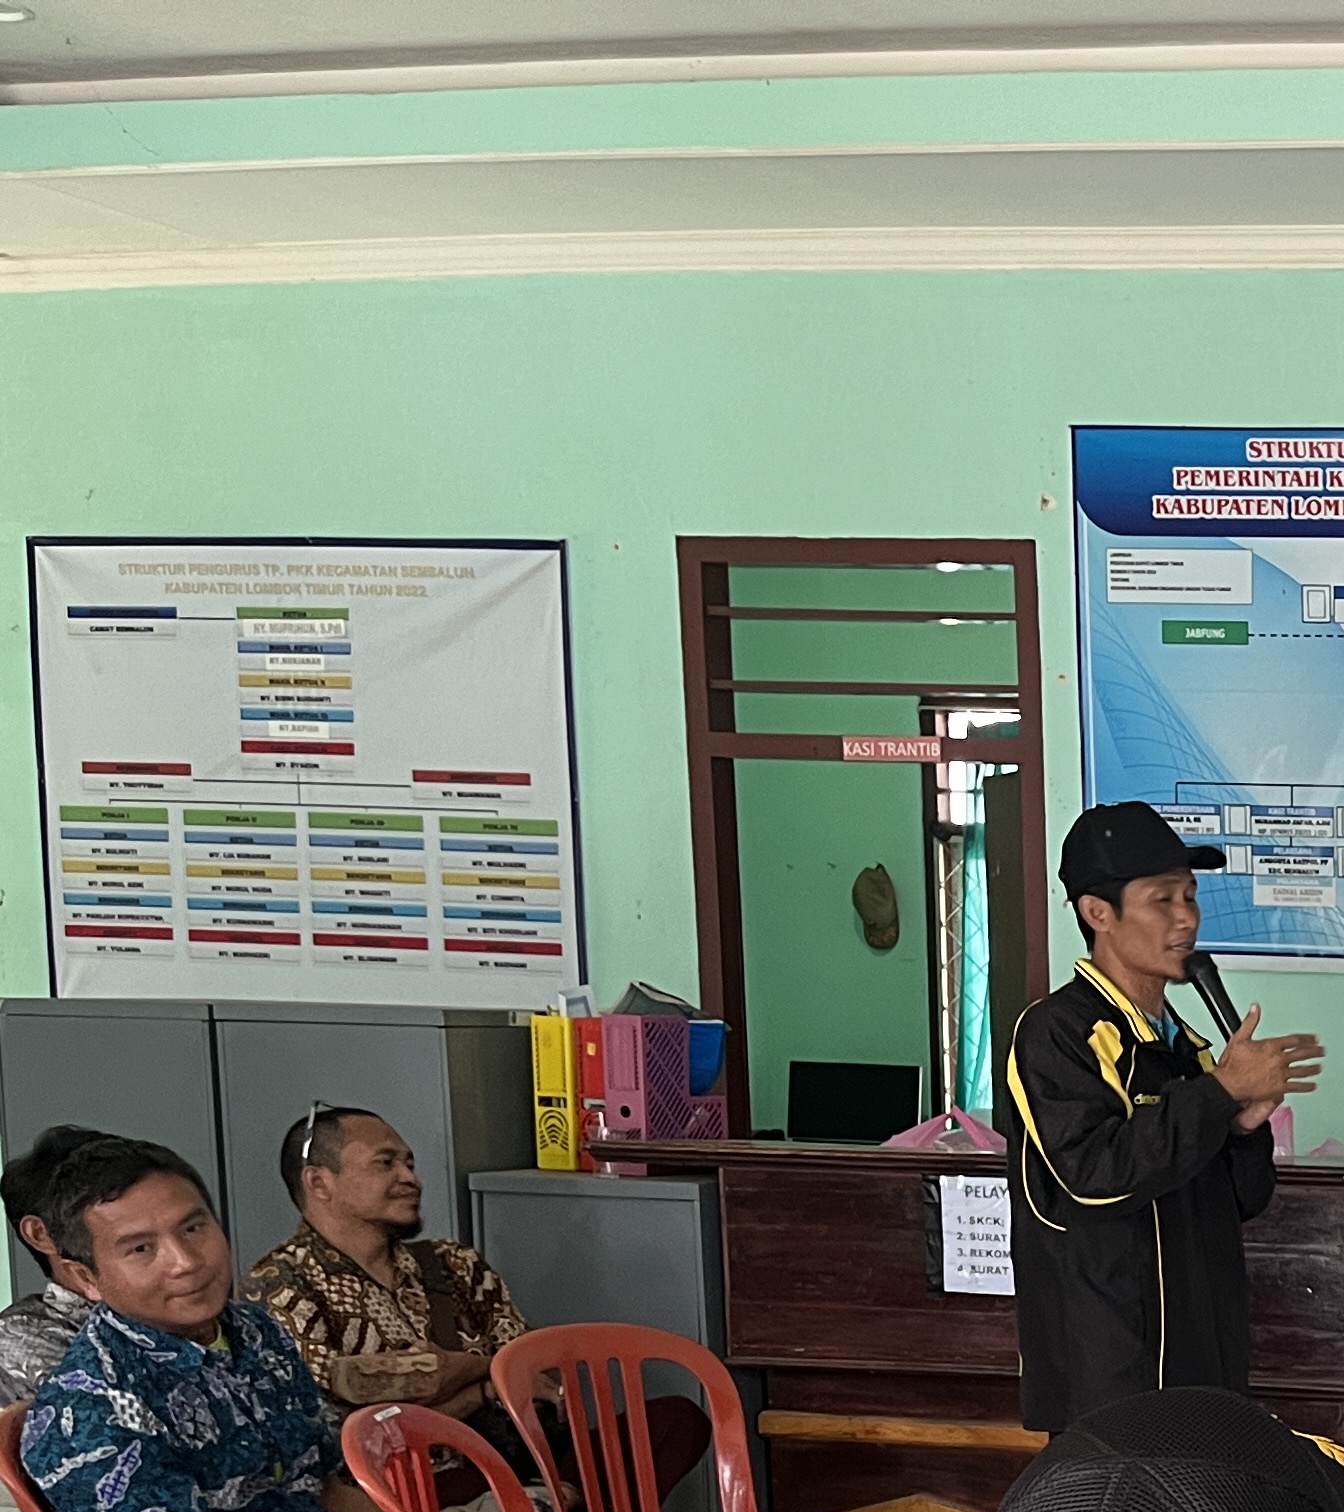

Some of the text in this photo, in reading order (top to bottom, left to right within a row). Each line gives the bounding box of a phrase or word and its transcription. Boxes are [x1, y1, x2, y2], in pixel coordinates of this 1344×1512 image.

[1174, 468, 1321, 488] PEMERINTAH
[1154, 497, 1286, 517] KABUPATEN
[118, 563, 186, 576] STRUKTUR
[188, 563, 261, 577] PENGURUS
[287, 564, 315, 577] PKK
[317, 564, 398, 578] KECAMATAN
[400, 565, 476, 579] SEMBALUN
[165, 582, 243, 595] KABUPATEN
[246, 582, 302, 596] LOMBOK
[306, 583, 345, 596] TIMUR
[348, 583, 393, 597] TAHUN
[1185, 627, 1226, 639] JABFUNG
[843, 741, 941, 757] KASI TRANTIB
[964, 1185, 1008, 1199] PELAY
[957, 1215, 967, 1225] 1.
[956, 1231, 1008, 1243] 2. SURAT
[970, 1265, 1010, 1276] SURAT
